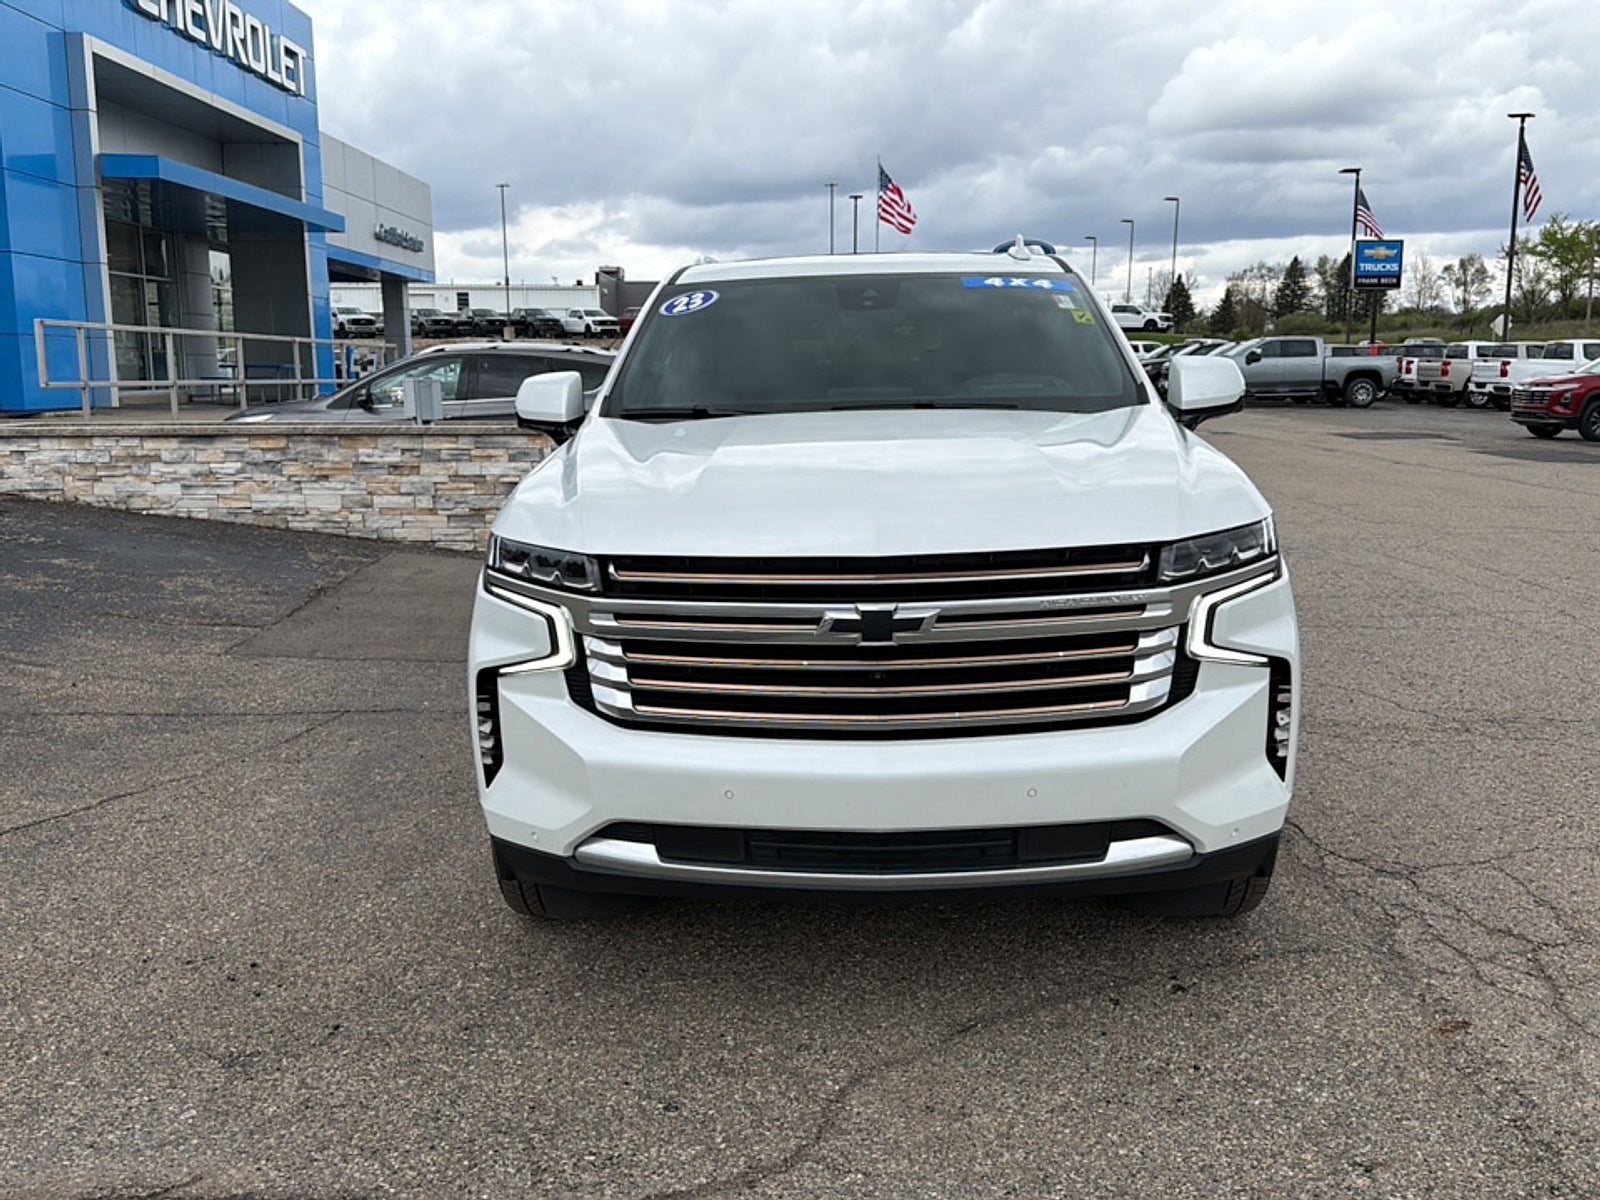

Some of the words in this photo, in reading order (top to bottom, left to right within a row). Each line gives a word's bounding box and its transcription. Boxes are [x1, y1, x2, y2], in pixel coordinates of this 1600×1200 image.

[137, 0, 306, 96] EVROLET
[1359, 263, 1399, 271] TRUCKS
[672, 293, 705, 313] 23
